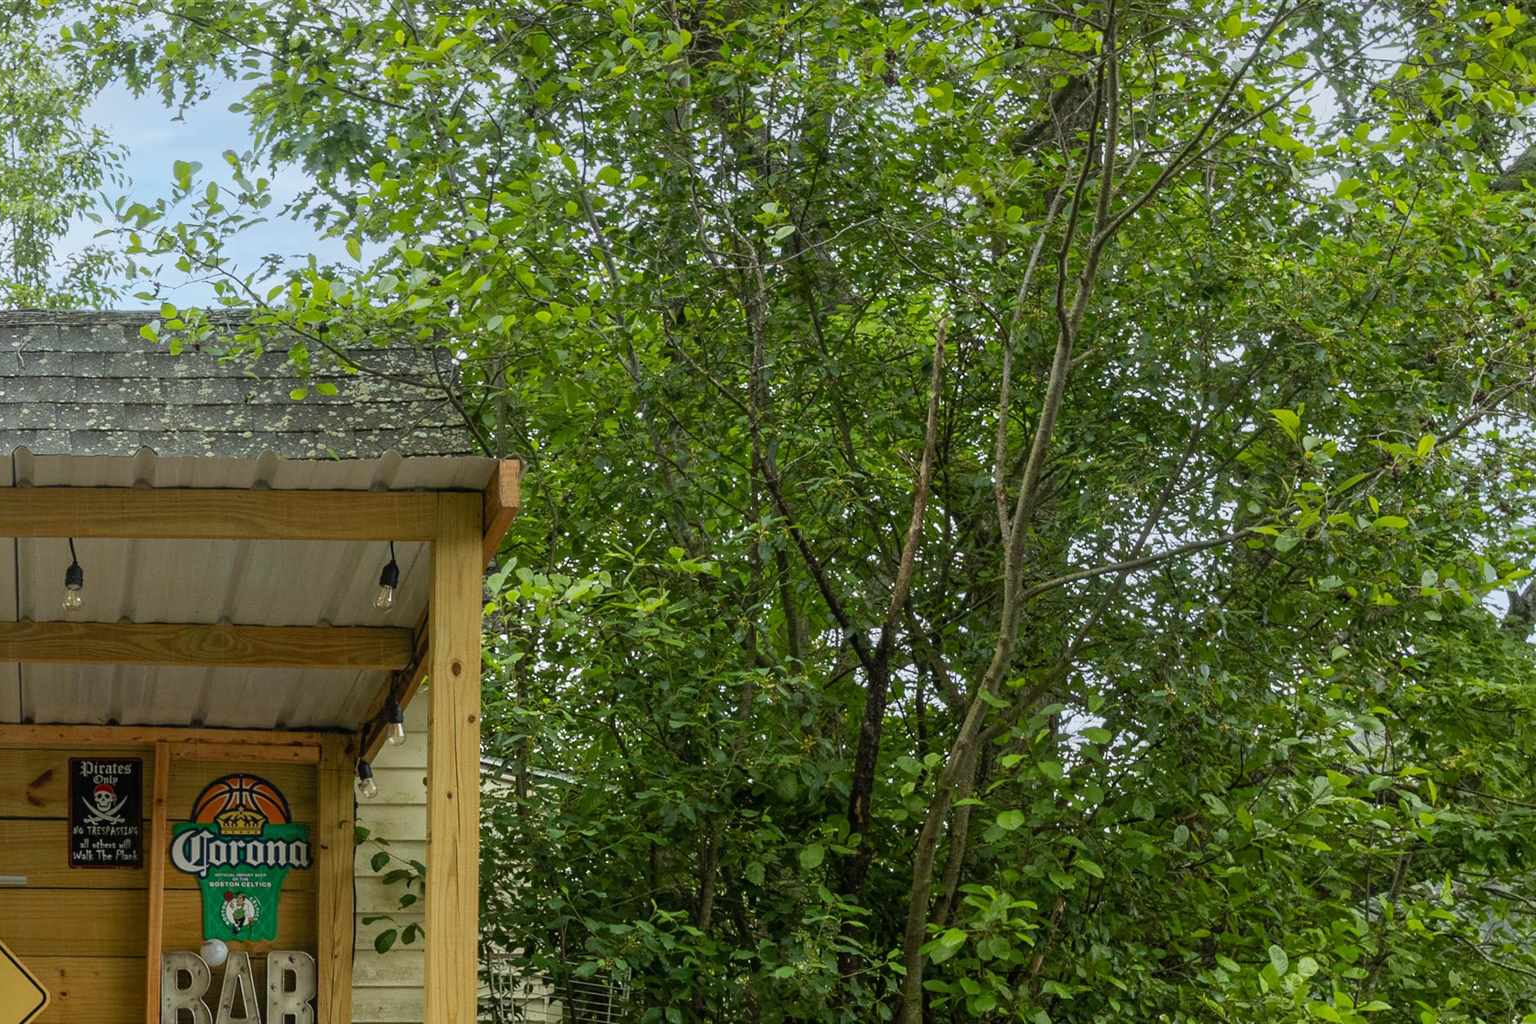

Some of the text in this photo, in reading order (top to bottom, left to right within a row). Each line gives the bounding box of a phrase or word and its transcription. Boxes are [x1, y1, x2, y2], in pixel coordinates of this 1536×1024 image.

[80, 761, 132, 776] Pirates
[93, 775, 118, 784] Only
[172, 830, 310, 877] Corona
